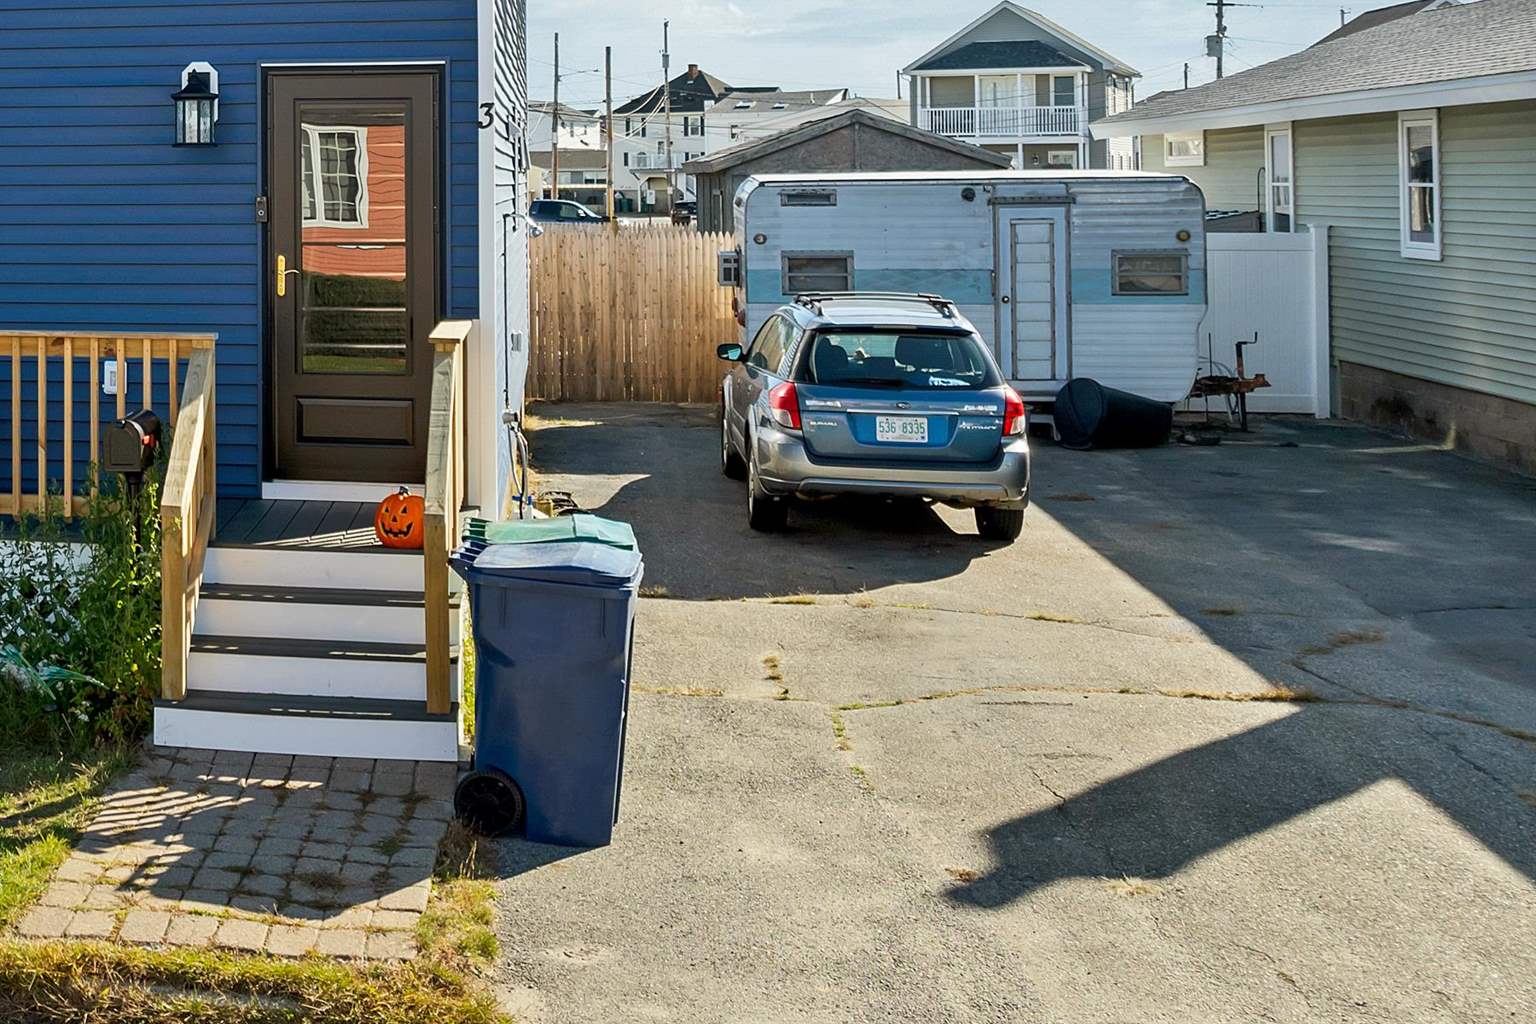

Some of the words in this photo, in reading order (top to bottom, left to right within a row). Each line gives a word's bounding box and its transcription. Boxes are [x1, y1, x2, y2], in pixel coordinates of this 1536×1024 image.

[476, 102, 494, 129] 3
[879, 422, 896, 433] 536
[902, 422, 925, 434] 8335
